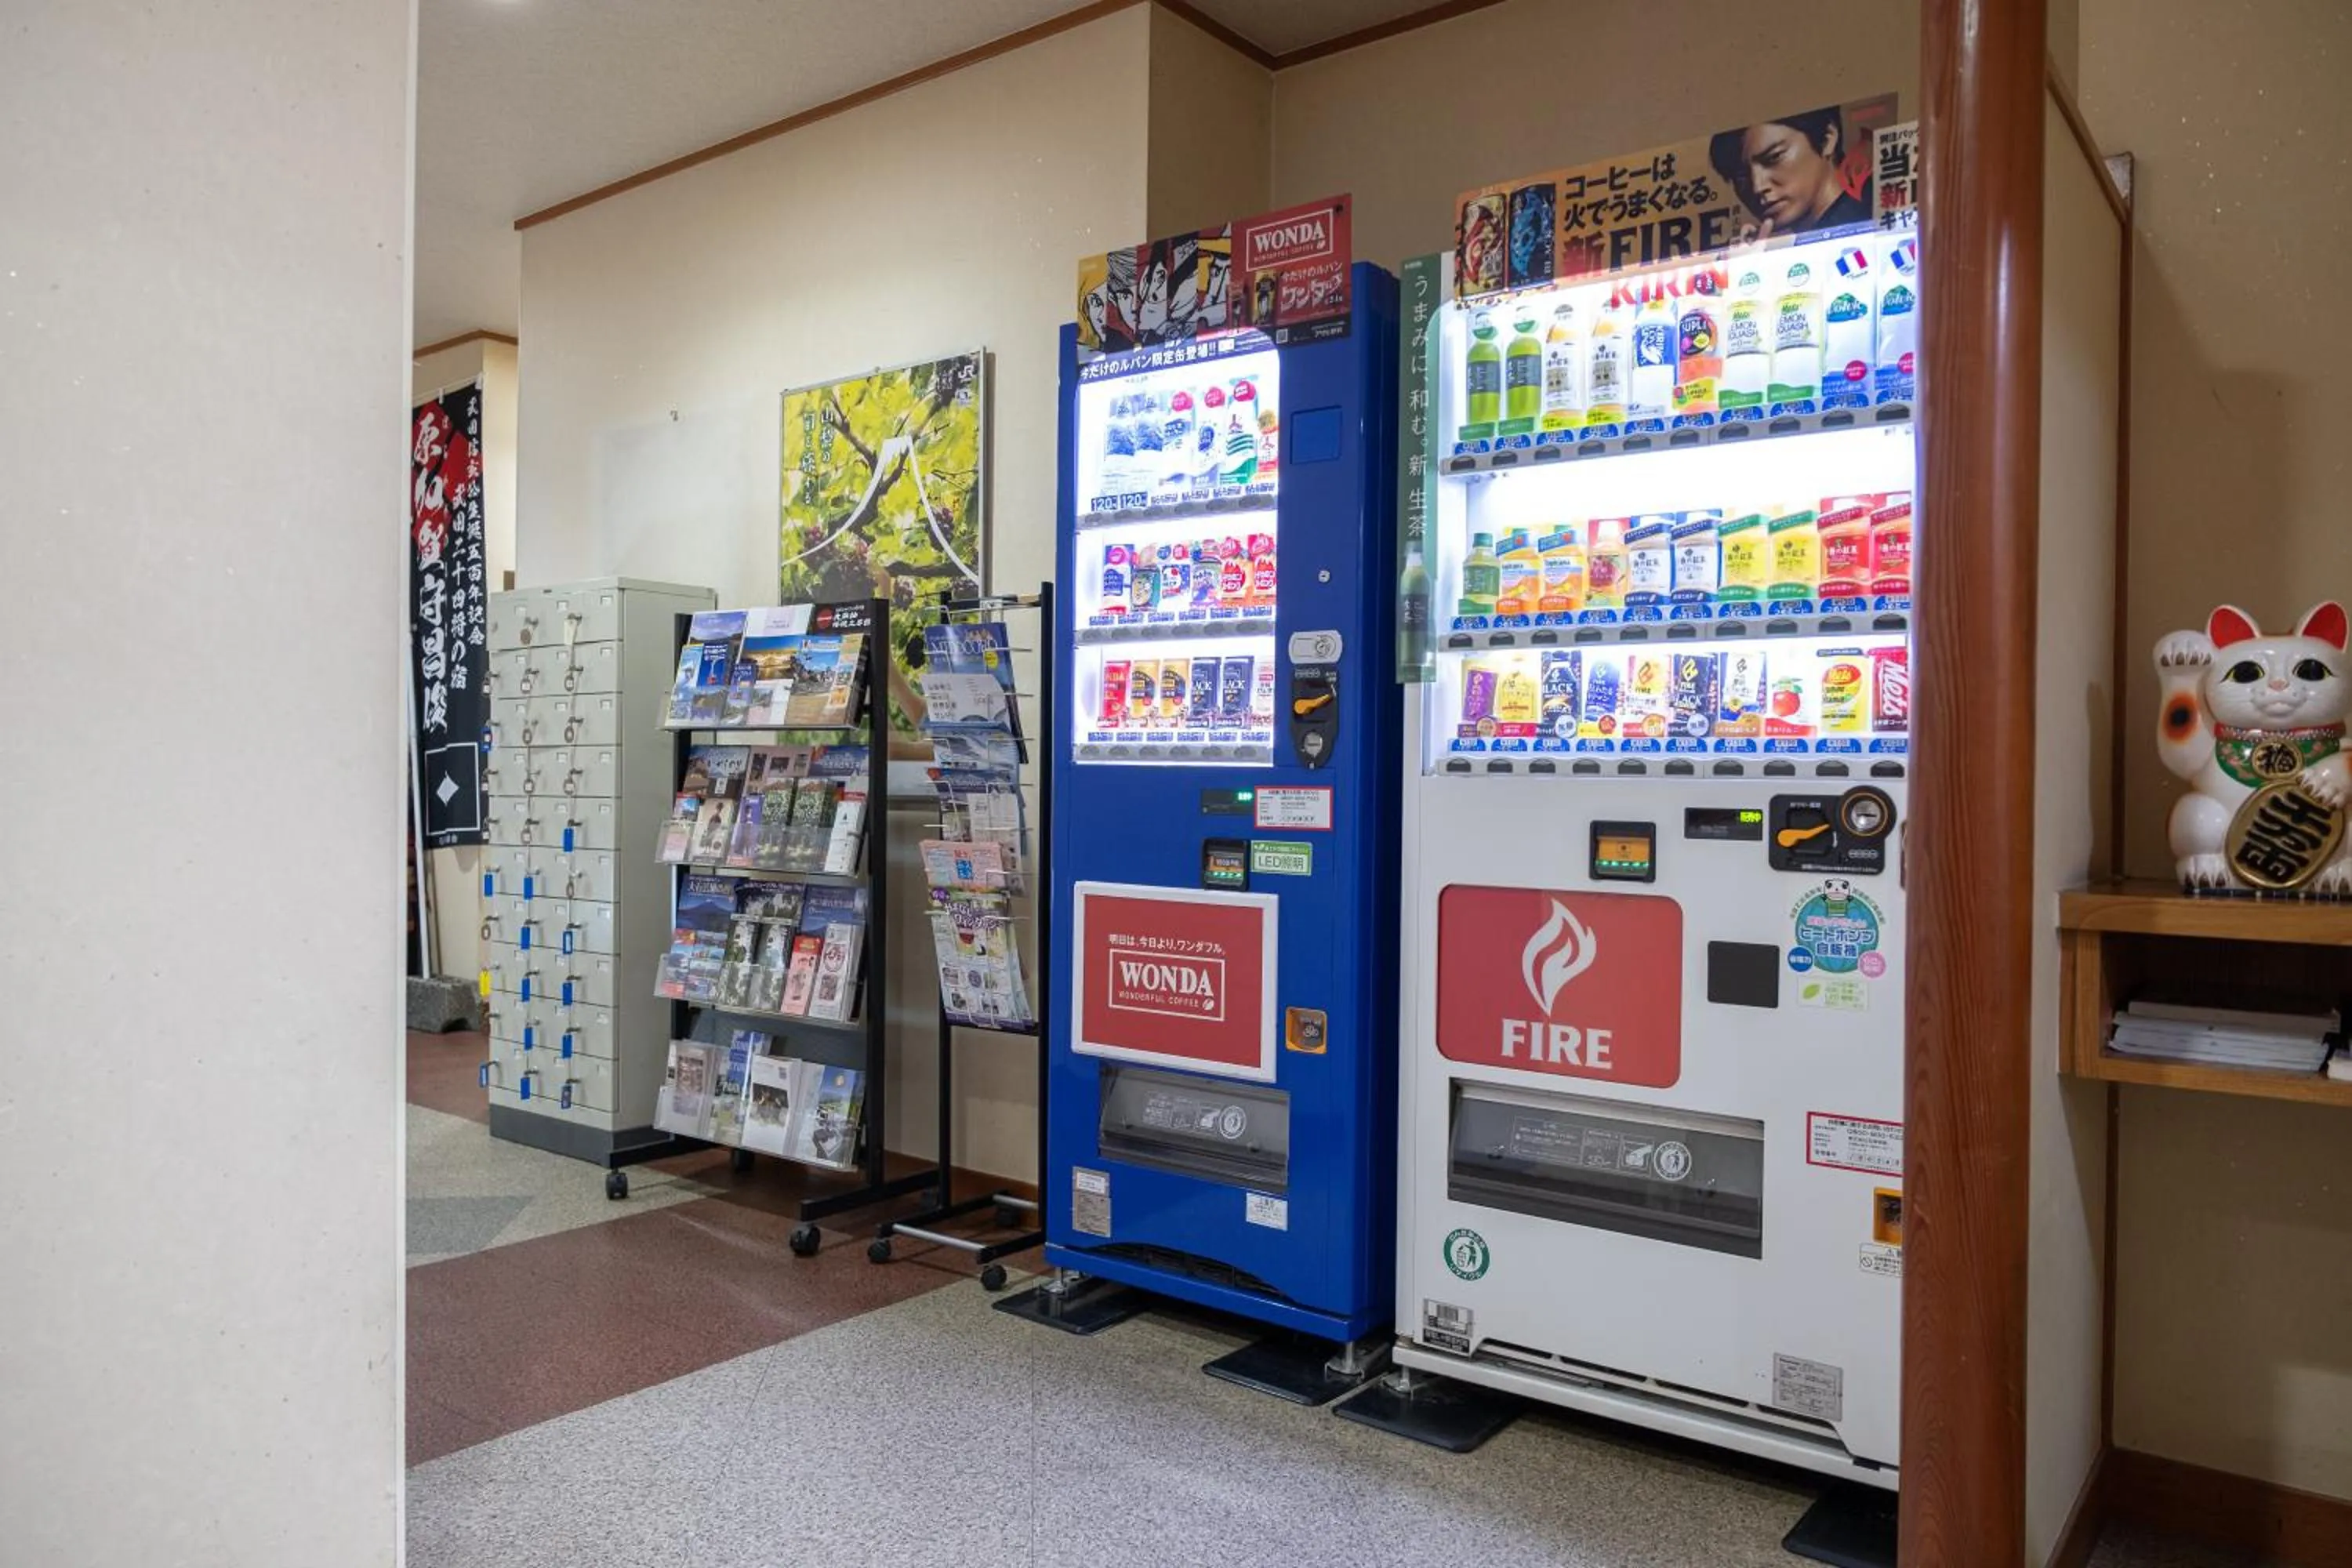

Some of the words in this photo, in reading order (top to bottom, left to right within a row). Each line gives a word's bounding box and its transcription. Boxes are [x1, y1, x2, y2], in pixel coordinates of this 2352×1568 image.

[1565, 154, 1675, 200] コーヒーは
[1879, 143, 1918, 182] 当
[1564, 176, 1719, 232] 火でうまくなる。
[1879, 180, 1918, 209] 新
[1254, 220, 1325, 252] WONDA
[2259, 742, 2297, 774] 福
[1801, 928, 1875, 944] ヒートポンプ
[1119, 960, 1214, 997] WONDA
[1501, 1018, 1613, 1069] FIRE
